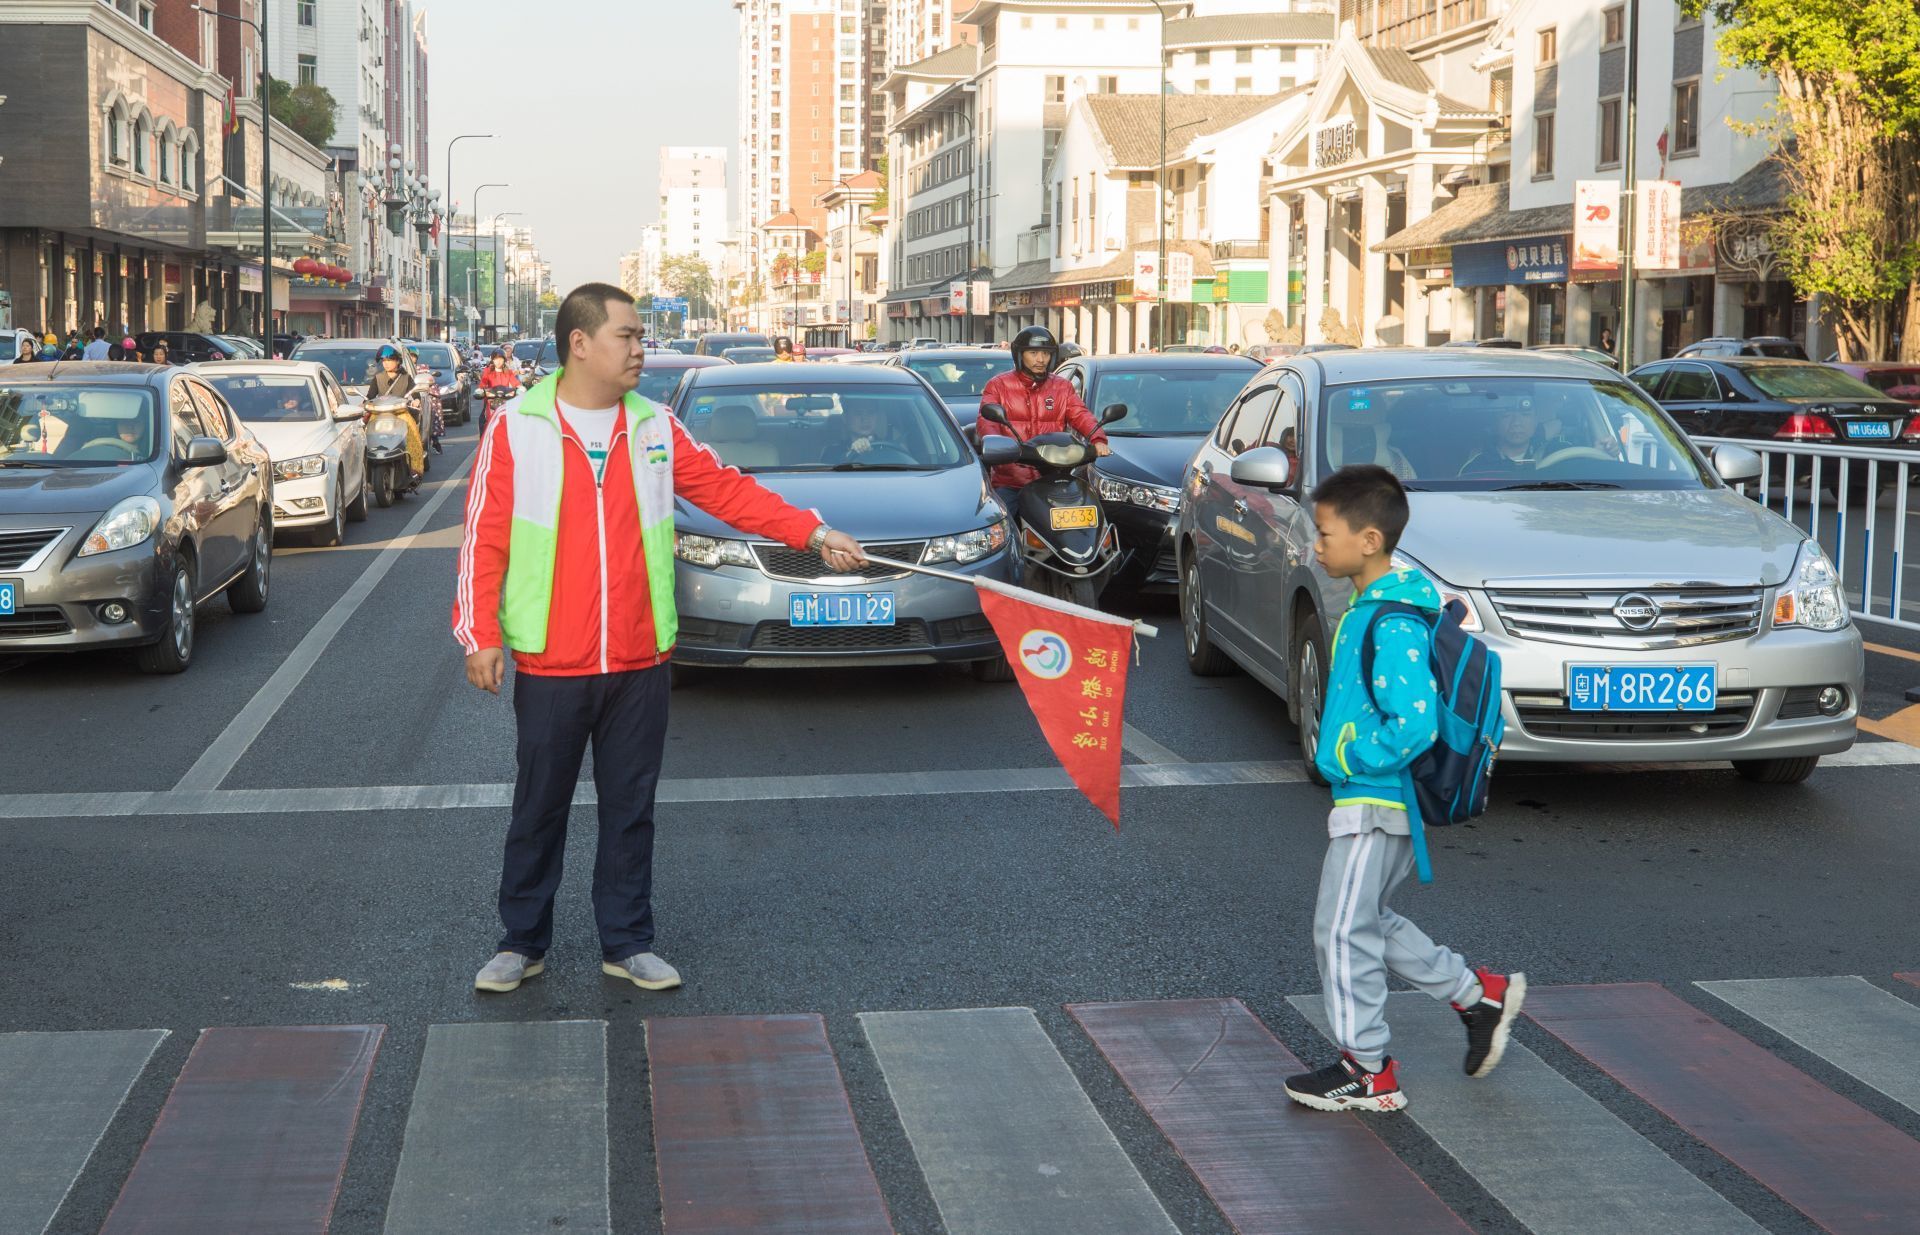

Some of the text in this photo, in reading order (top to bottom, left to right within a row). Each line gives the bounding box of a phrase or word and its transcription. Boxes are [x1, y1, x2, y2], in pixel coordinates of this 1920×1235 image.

[1585, 204, 1611, 222] 70
[1518, 243, 1564, 268] 贝贝教育
